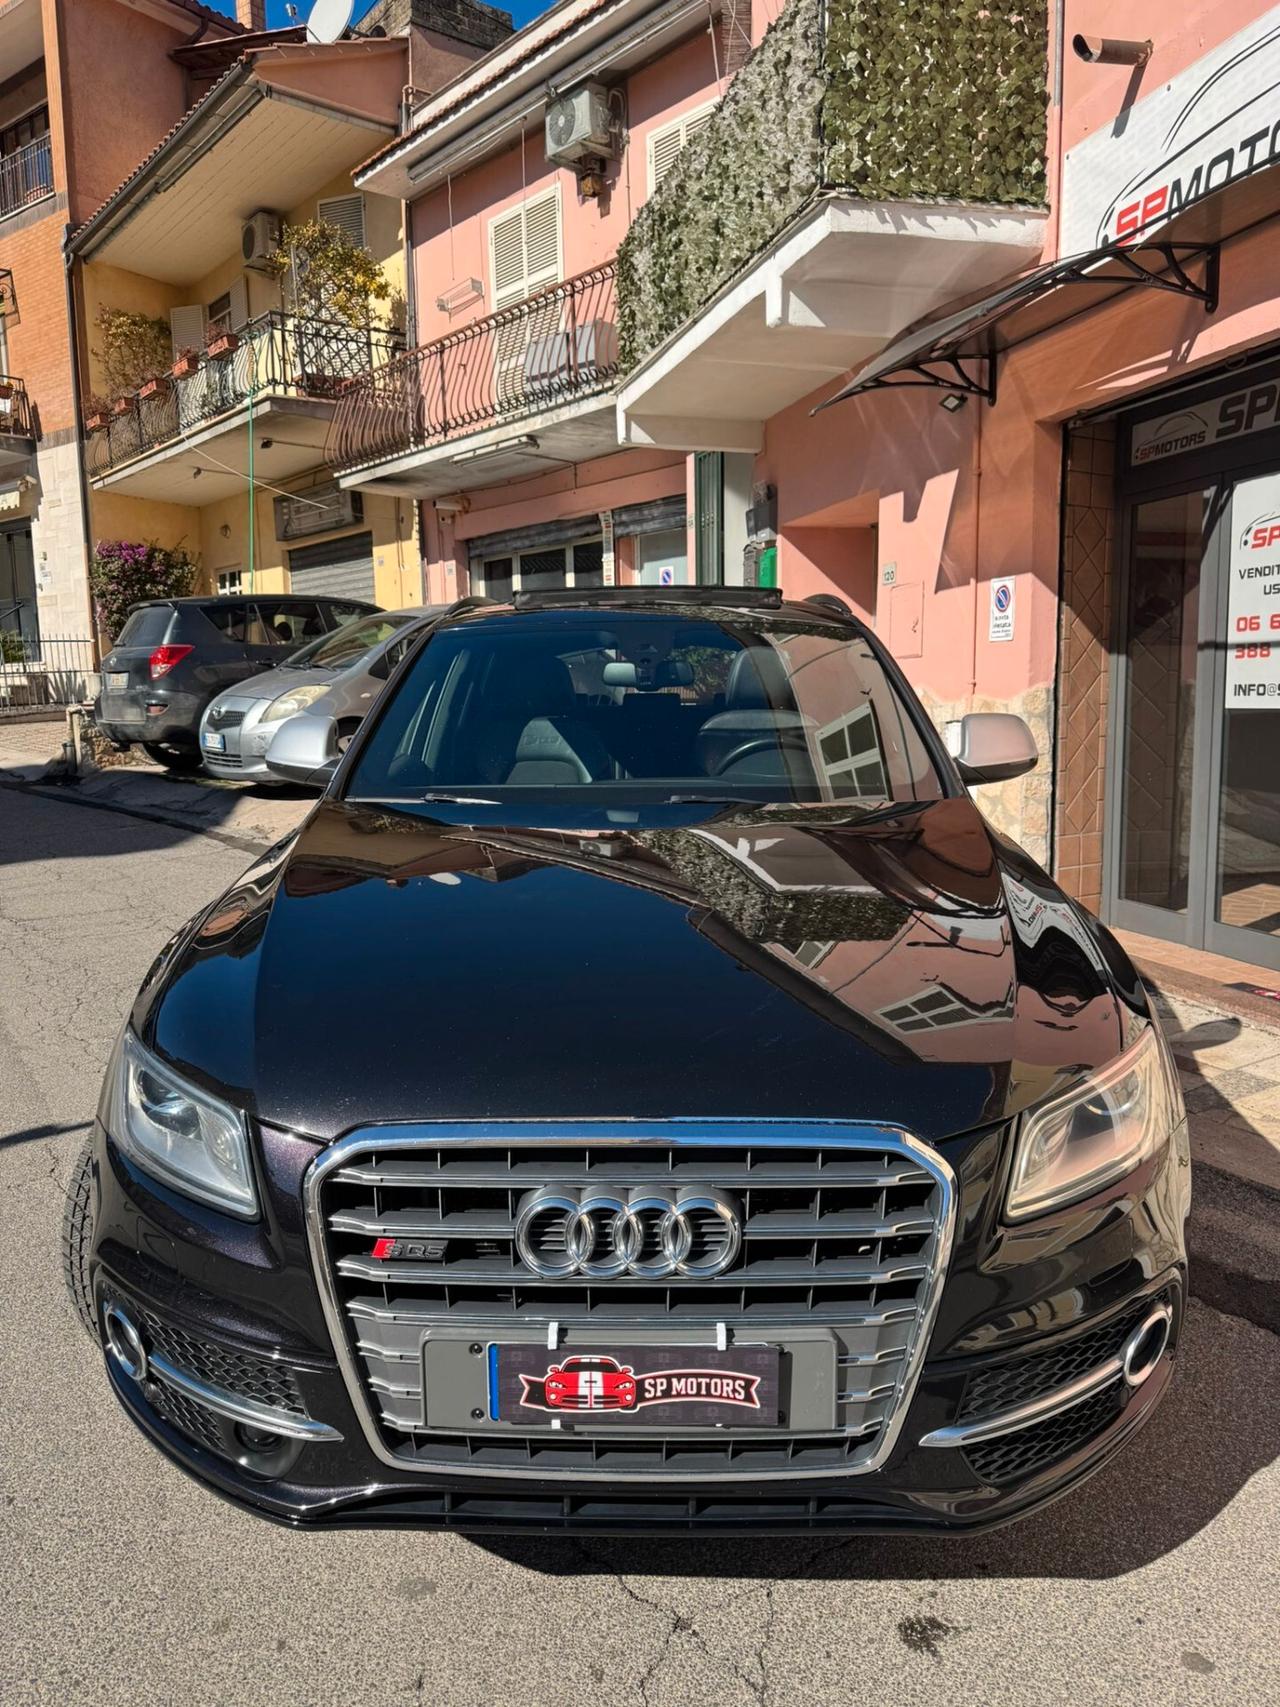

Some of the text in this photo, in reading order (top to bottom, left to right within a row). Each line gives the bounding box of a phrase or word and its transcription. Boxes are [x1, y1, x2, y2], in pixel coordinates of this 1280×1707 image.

[1138, 430, 1206, 461] SPMOTORS
[1251, 525, 1280, 549] SP
[1263, 583, 1280, 595] US
[1236, 616, 1260, 632] 06
[1235, 641, 1271, 659] 388
[644, 1377, 745, 1400] SP MOTORS
